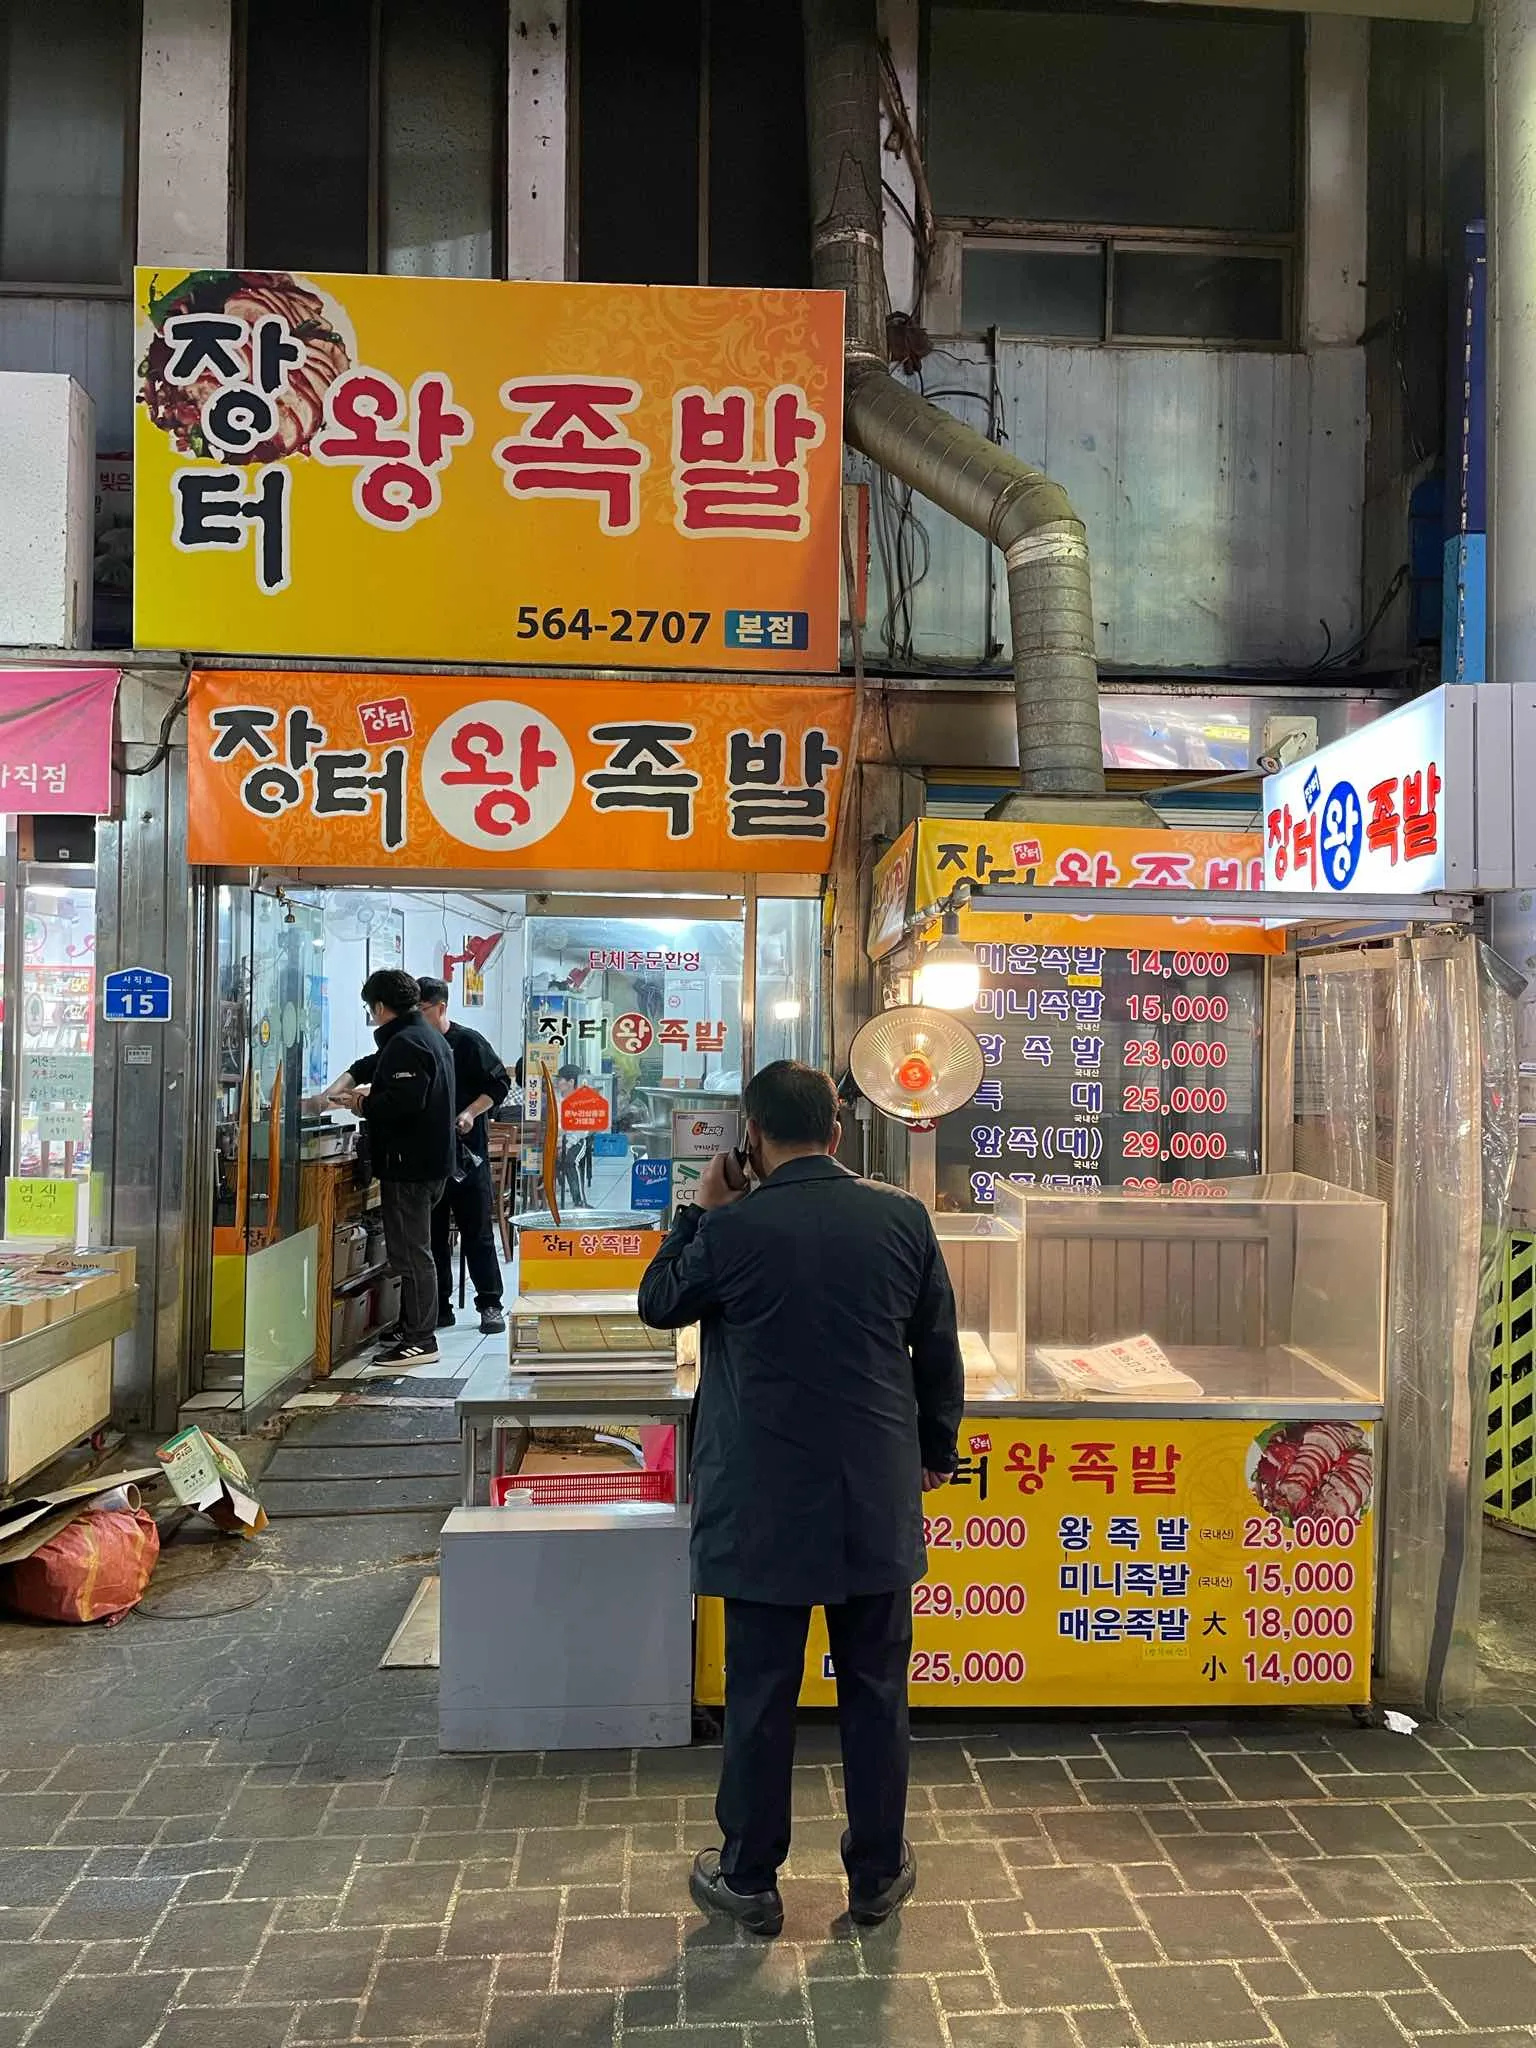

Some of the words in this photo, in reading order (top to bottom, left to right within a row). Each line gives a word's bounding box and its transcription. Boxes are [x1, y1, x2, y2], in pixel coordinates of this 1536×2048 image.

[168, 318, 304, 590] 장터
[516, 606, 711, 645] 564-2707
[735, 604, 794, 645] 본점
[361, 706, 410, 733] 장터
[211, 707, 408, 851] 장터
[1014, 842, 1042, 862] 장터
[589, 950, 700, 972] 단체주문환영
[974, 943, 1105, 975] 매운족발
[1126, 949, 1230, 978] 14,000
[121, 994, 154, 1015] 15
[973, 988, 1105, 1023] 미니족발
[1125, 995, 1230, 1025] 15,000
[1075, 1023, 1100, 1032] 국내산
[1123, 1039, 1229, 1071] 23,000
[1074, 1069, 1100, 1078] 국내산
[1122, 1085, 1228, 1117] 25,000
[1073, 1114, 1099, 1123] 국내산
[1122, 1130, 1228, 1162] 29,000
[1073, 1160, 1099, 1169] 국내산
[676, 1189, 698, 1200] CCT
[542, 1234, 573, 1257] 장터
[969, 1437, 992, 1449] 장터
[1199, 1528, 1234, 1541] (국내산)
[1242, 1516, 1356, 1552] 23,000
[1058, 1561, 1190, 1597] 미니족발
[1198, 1576, 1233, 1589] (국내산)
[1243, 1561, 1356, 1596] 15,000
[912, 1583, 1026, 1619] 29,000
[1058, 1607, 1190, 1642] 매운족발
[1202, 1611, 1227, 1637] 大
[1243, 1606, 1355, 1641] 18,000
[910, 1651, 1025, 1687] 25,000
[1201, 1655, 1228, 1682] 小
[1242, 1651, 1354, 1686] 14,000
